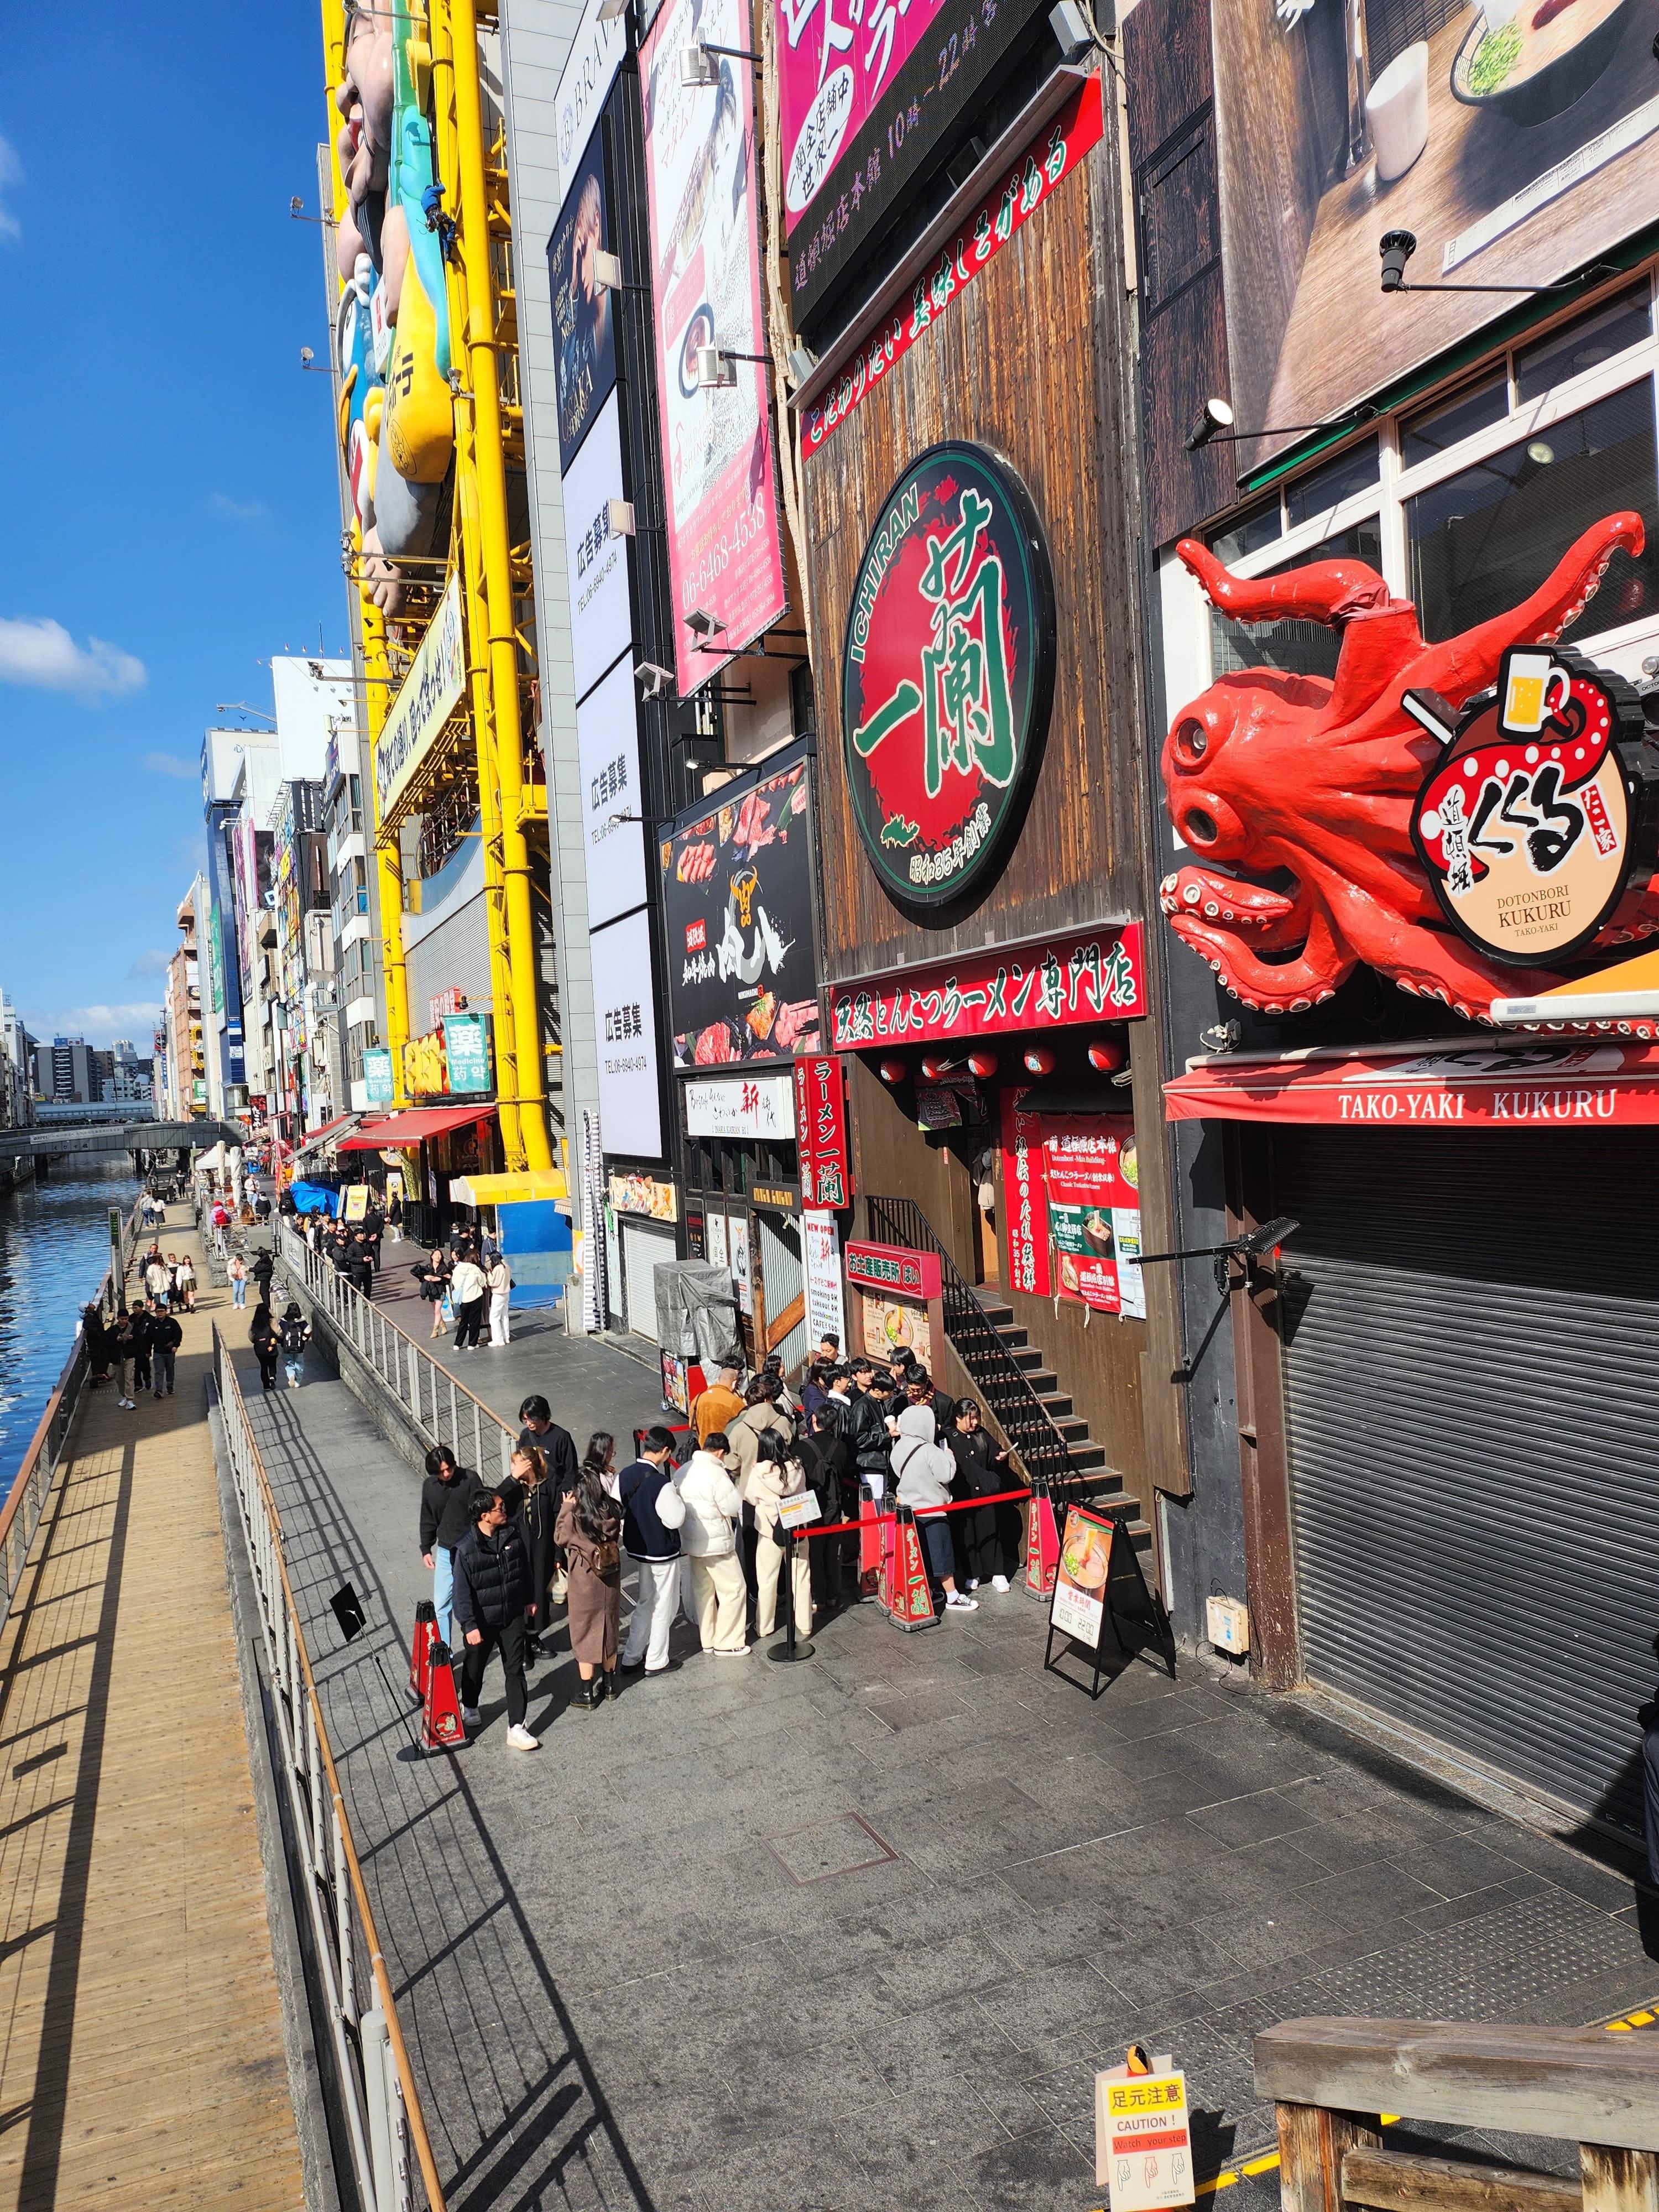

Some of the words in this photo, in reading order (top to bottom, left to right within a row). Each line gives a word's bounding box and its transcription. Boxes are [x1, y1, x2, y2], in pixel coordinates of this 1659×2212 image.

[802, 128, 838, 203] 世界一
[810, 125, 1066, 441] こだわりたい美味しさがある
[682, 492, 765, 609] 06-6468-4538
[851, 483, 920, 663] ICHIRAN
[853, 487, 1017, 800] 一蘭
[591, 753, 627, 812] 広告募集
[1469, 762, 1584, 876] くくる
[1585, 787, 1616, 854] たこ家
[909, 801, 992, 884] 昭和35年創業
[1441, 785, 1473, 895] 道頓堀
[1497, 885, 1569, 909] DOTONBORI
[1498, 900, 1571, 930] KUKURU
[1515, 923, 1558, 937] TAKO-YAKI
[835, 941, 1137, 1043] 天然とんこつラーメン専門店
[451, 1024, 483, 1056] 薬
[605, 1002, 642, 1042] 広告募集
[367, 1056, 390, 1078] 薬
[451, 1058, 485, 1066] Medicine
[605, 1056, 647, 1074] TEL:06-6940-4974
[1338, 1093, 1464, 1119] TAKO-YAKI
[1491, 1088, 1618, 1118] KUKURU
[797, 1067, 813, 1201] ラーメン一蘭
[814, 1061, 845, 1206] ラーメン一蘭
[807, 1222, 818, 1233] NEW
[820, 1225, 834, 1236] OPEN
[848, 1253, 900, 1284] お土産販売所
[903, 1265, 920, 1285] はい
[811, 1288, 830, 1301] smoking
[831, 1293, 838, 1302] OK
[831, 1304, 838, 1313] OK
[906, 1528, 930, 1616] ラーメン一蘭
[1112, 2083, 1181, 2109] 足元注意
[1114, 2138, 1141, 2150] Watch
[1147, 2137, 1166, 2147] your
[1169, 2134, 1186, 2146] step
[1118, 2117, 1167, 2132] CAUTION
